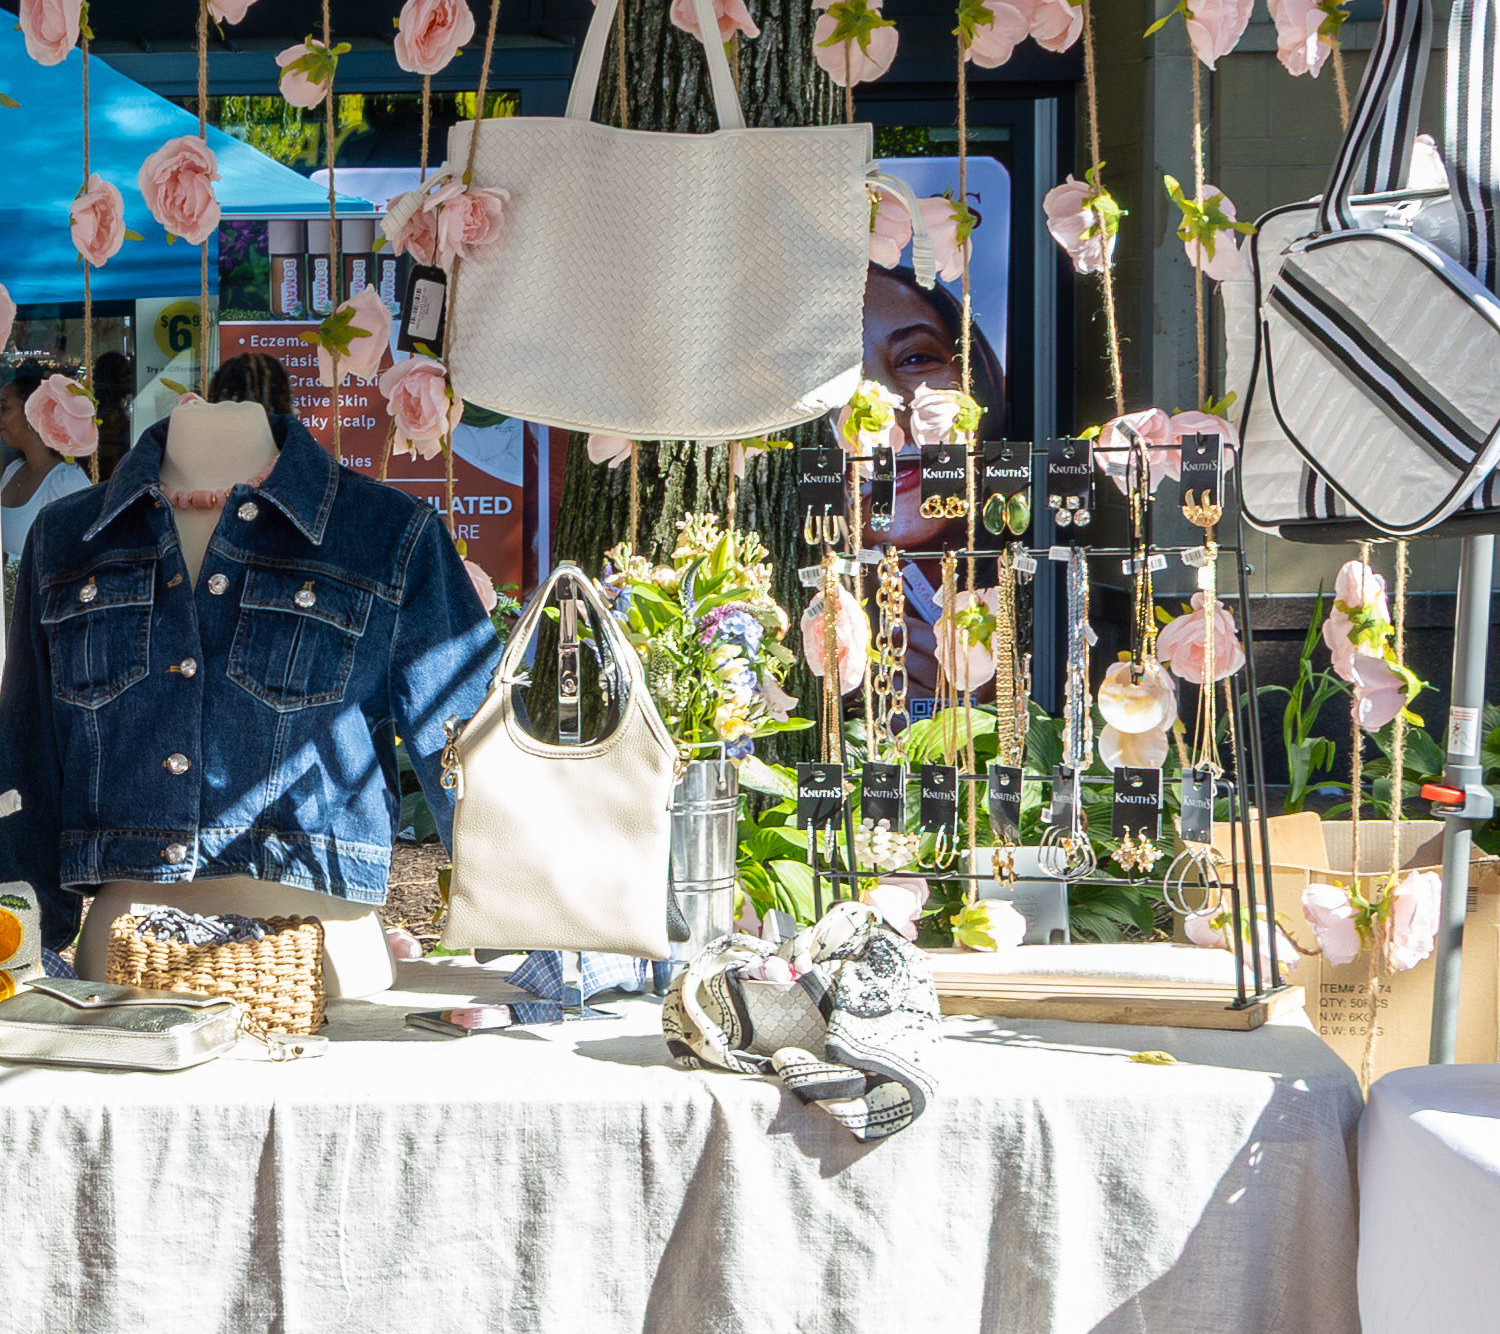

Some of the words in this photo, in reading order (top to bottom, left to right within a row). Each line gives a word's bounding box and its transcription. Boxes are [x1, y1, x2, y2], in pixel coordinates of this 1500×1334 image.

[353, 260, 365, 296] BOMA
[251, 335, 309, 347] Eczema
[281, 356, 320, 367] riasis
[289, 375, 350, 388] Cracd
[356, 375, 380, 387] Ski
[292, 395, 331, 408] stive
[299, 415, 328, 430] laky
[340, 456, 372, 468] bies
[1350, 1026, 1384, 1036] 6.5G
